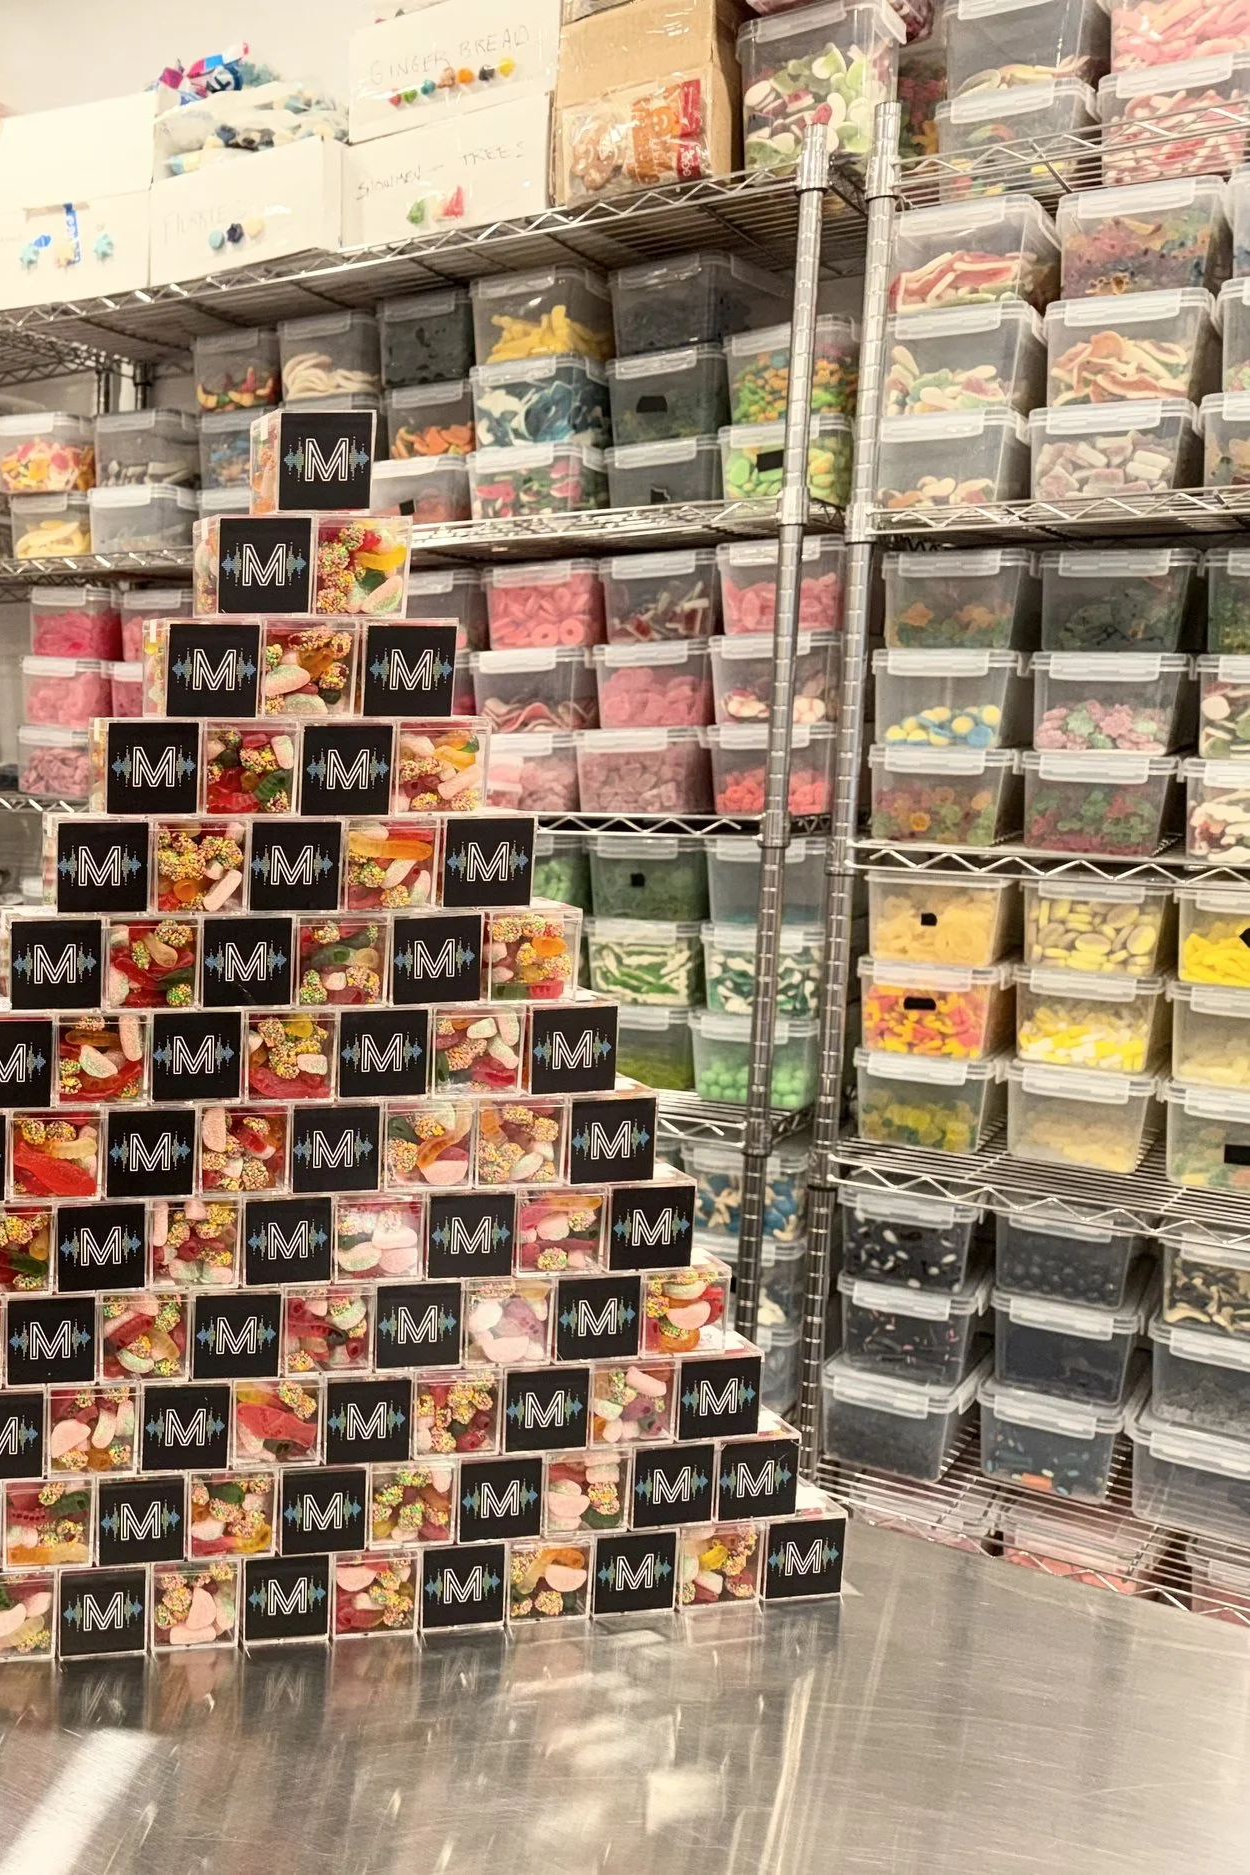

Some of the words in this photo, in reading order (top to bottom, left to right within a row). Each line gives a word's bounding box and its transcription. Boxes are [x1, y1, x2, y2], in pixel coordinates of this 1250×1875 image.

[305, 438, 348, 481] M
[243, 544, 286, 586] M
[193, 649, 236, 690] M
[390, 649, 433, 690] M
[133, 747, 175, 787] M
[327, 749, 369, 789] M
[79, 846, 121, 886] M
[271, 846, 313, 885] M
[467, 842, 509, 881] M
[34, 944, 76, 984] M
[225, 942, 266, 981] M
[414, 939, 455, 979] M
[173, 1035, 214, 1074] M
[361, 1034, 402, 1072] M
[552, 1030, 592, 1069] M
[130, 1133, 171, 1171] M
[313, 1130, 353, 1168] M
[591, 1121, 631, 1159] M
[268, 1221, 308, 1259] M
[451, 1216, 491, 1254] M
[632, 1208, 672, 1246] M
[81, 1227, 121, 1266] M
[216, 1317, 257, 1354] M
[398, 1306, 437, 1344] M
[578, 1298, 617, 1336] M
[30, 1321, 71, 1359] M
[525, 1391, 564, 1428] M
[700, 1378, 738, 1416] M
[165, 1409, 206, 1446] M
[347, 1402, 386, 1440] M
[653, 1467, 690, 1504] M
[737, 1460, 774, 1498] M
[304, 1493, 343, 1531] M
[481, 1480, 519, 1518] M
[121, 1501, 160, 1541] M
[616, 1554, 654, 1590] M
[785, 1539, 822, 1576] M
[268, 1577, 307, 1615] M
[444, 1566, 482, 1604] M
[84, 1592, 123, 1631] M
